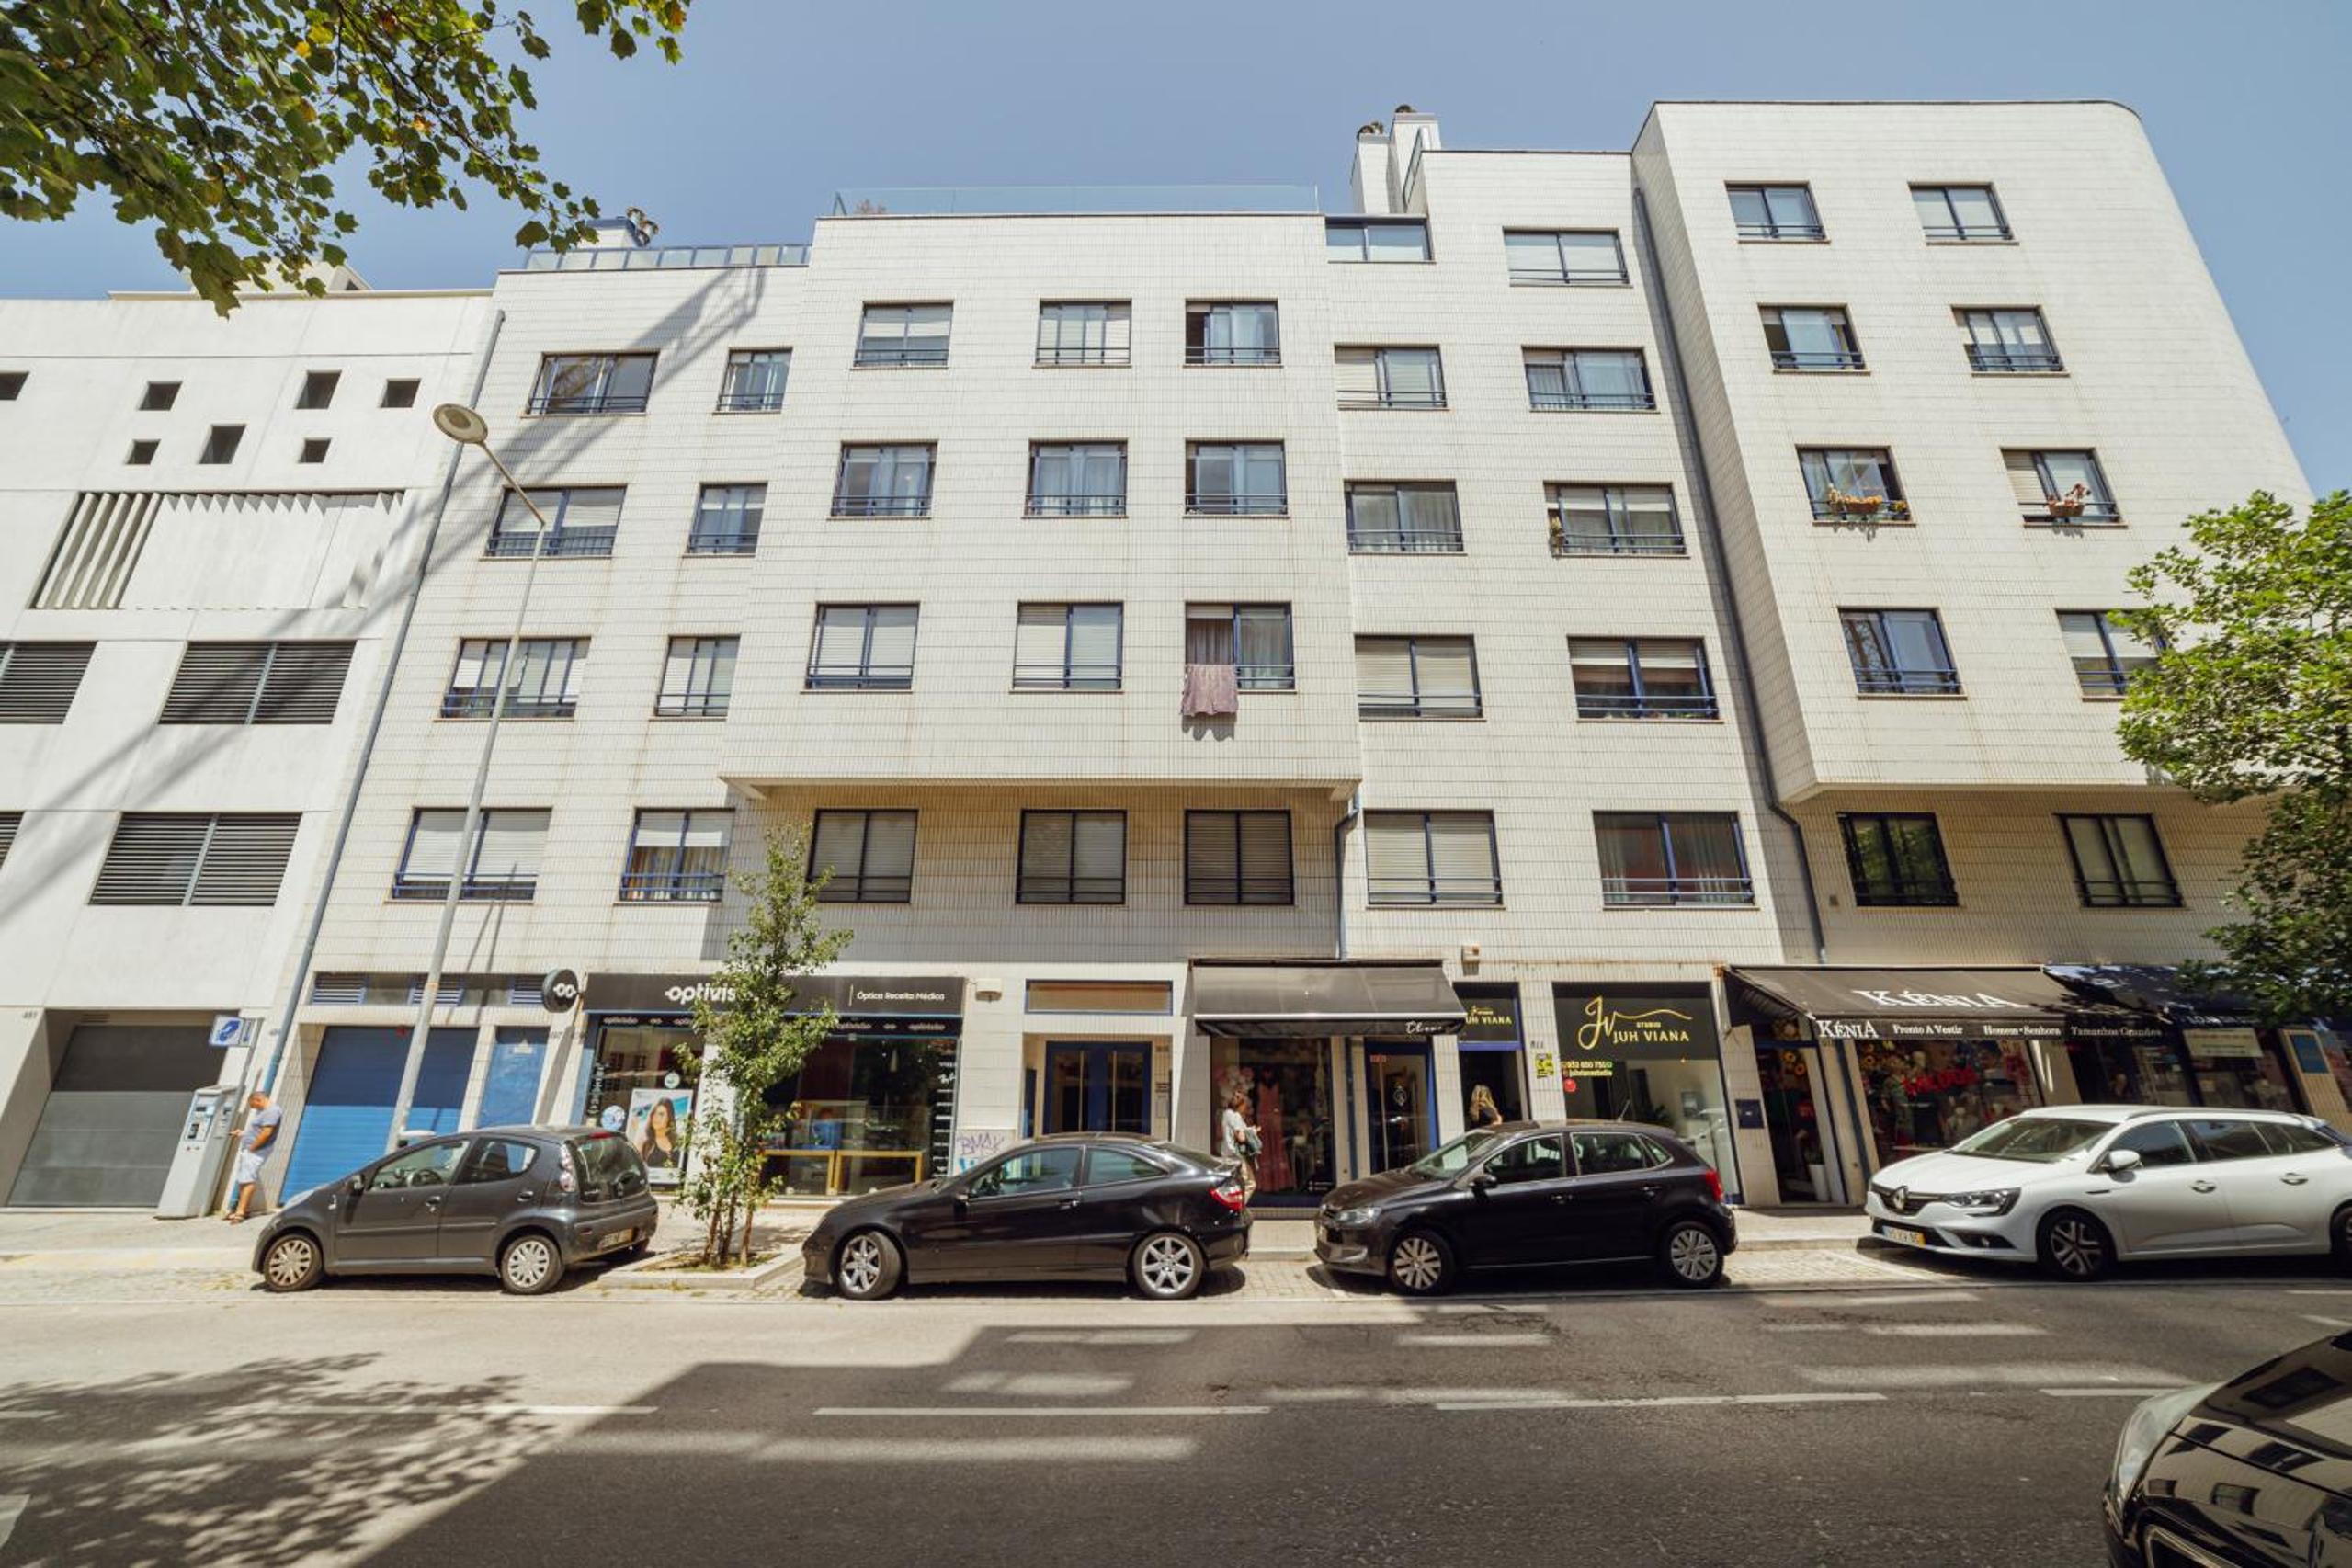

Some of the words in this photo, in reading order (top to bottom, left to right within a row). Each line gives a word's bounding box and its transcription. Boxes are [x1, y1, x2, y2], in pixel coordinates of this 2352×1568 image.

[1481, 1016, 1512, 1025] VIANA
[1816, 1019, 1880, 1039] KÉNIA
[1892, 1024, 1924, 1035] Pronto
[1613, 1030, 1639, 1044] JUH
[1643, 1030, 1689, 1042] VIANA
